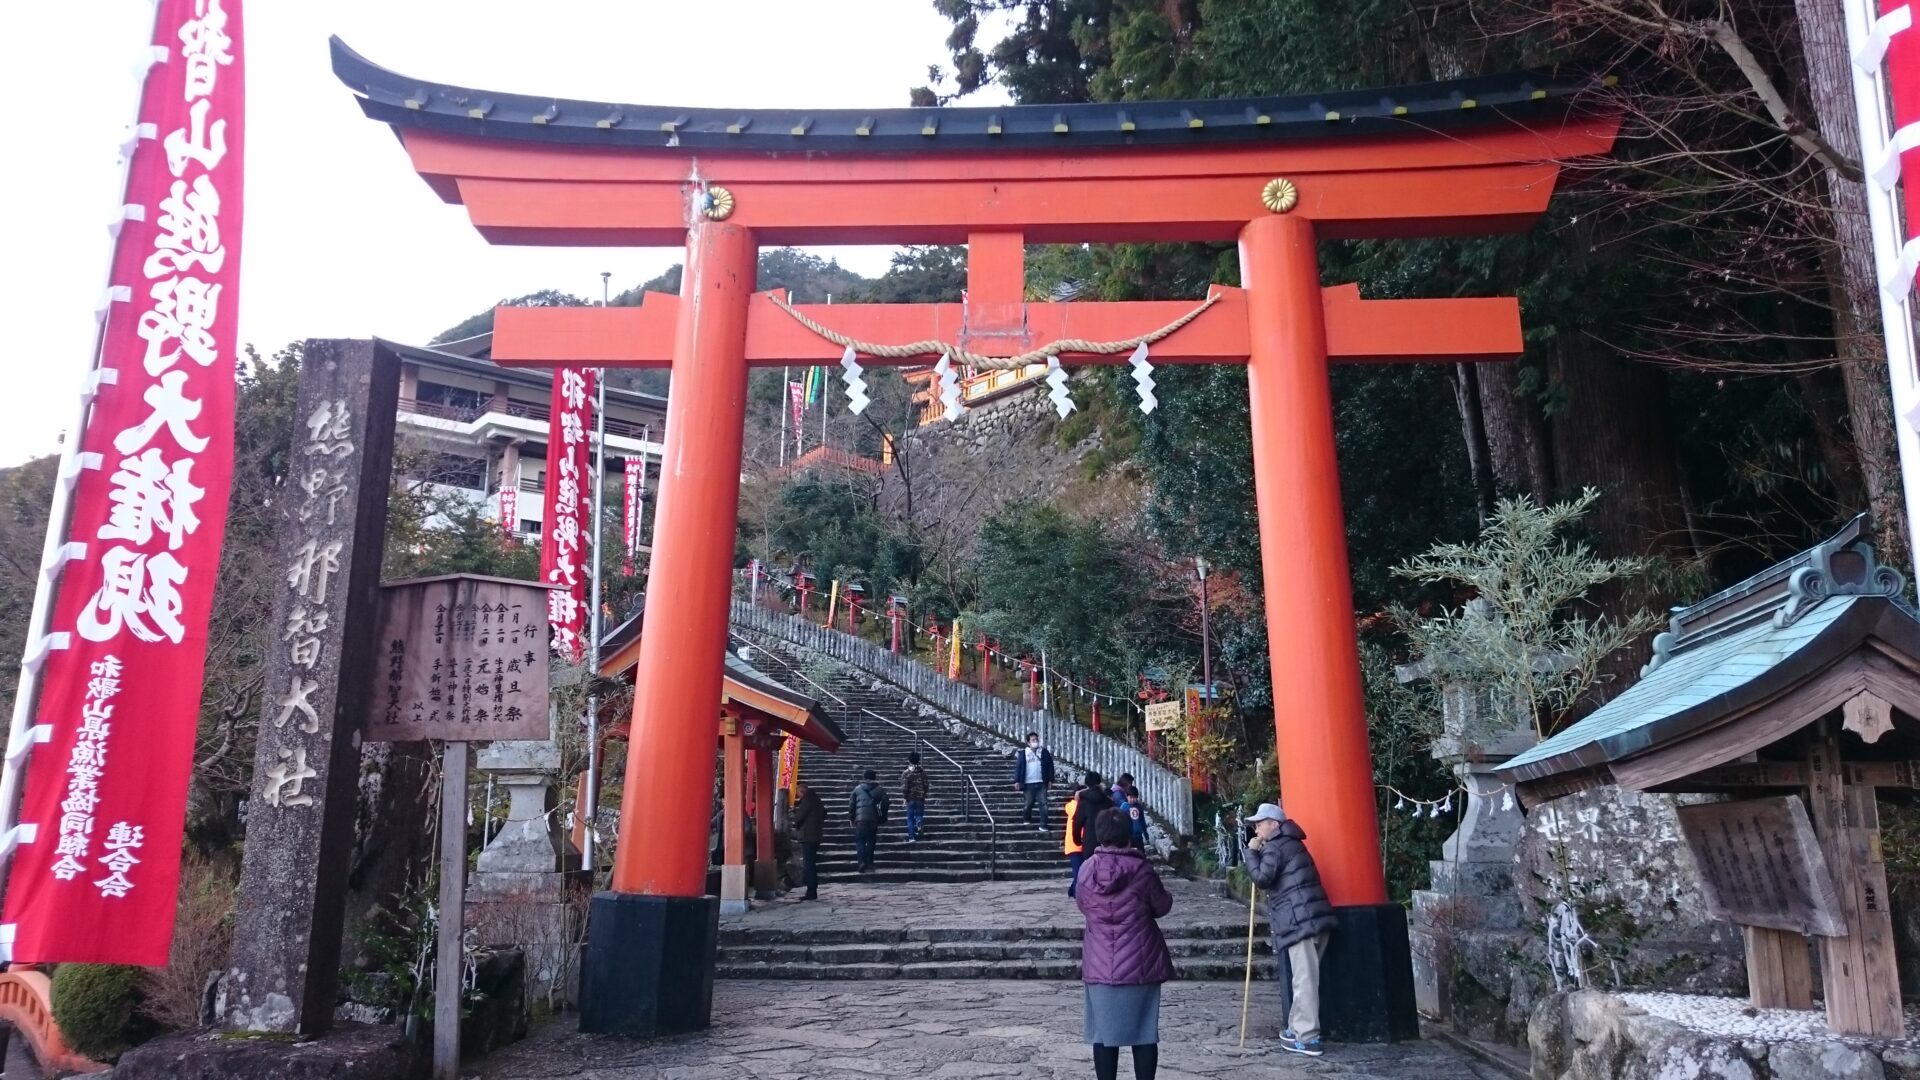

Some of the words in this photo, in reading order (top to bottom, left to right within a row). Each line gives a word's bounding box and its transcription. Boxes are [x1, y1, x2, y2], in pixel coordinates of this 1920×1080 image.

[262, 401, 354, 807] 熊野那智大社
[511, 604, 522, 644] 一月一日
[524, 624, 538, 667] 行事
